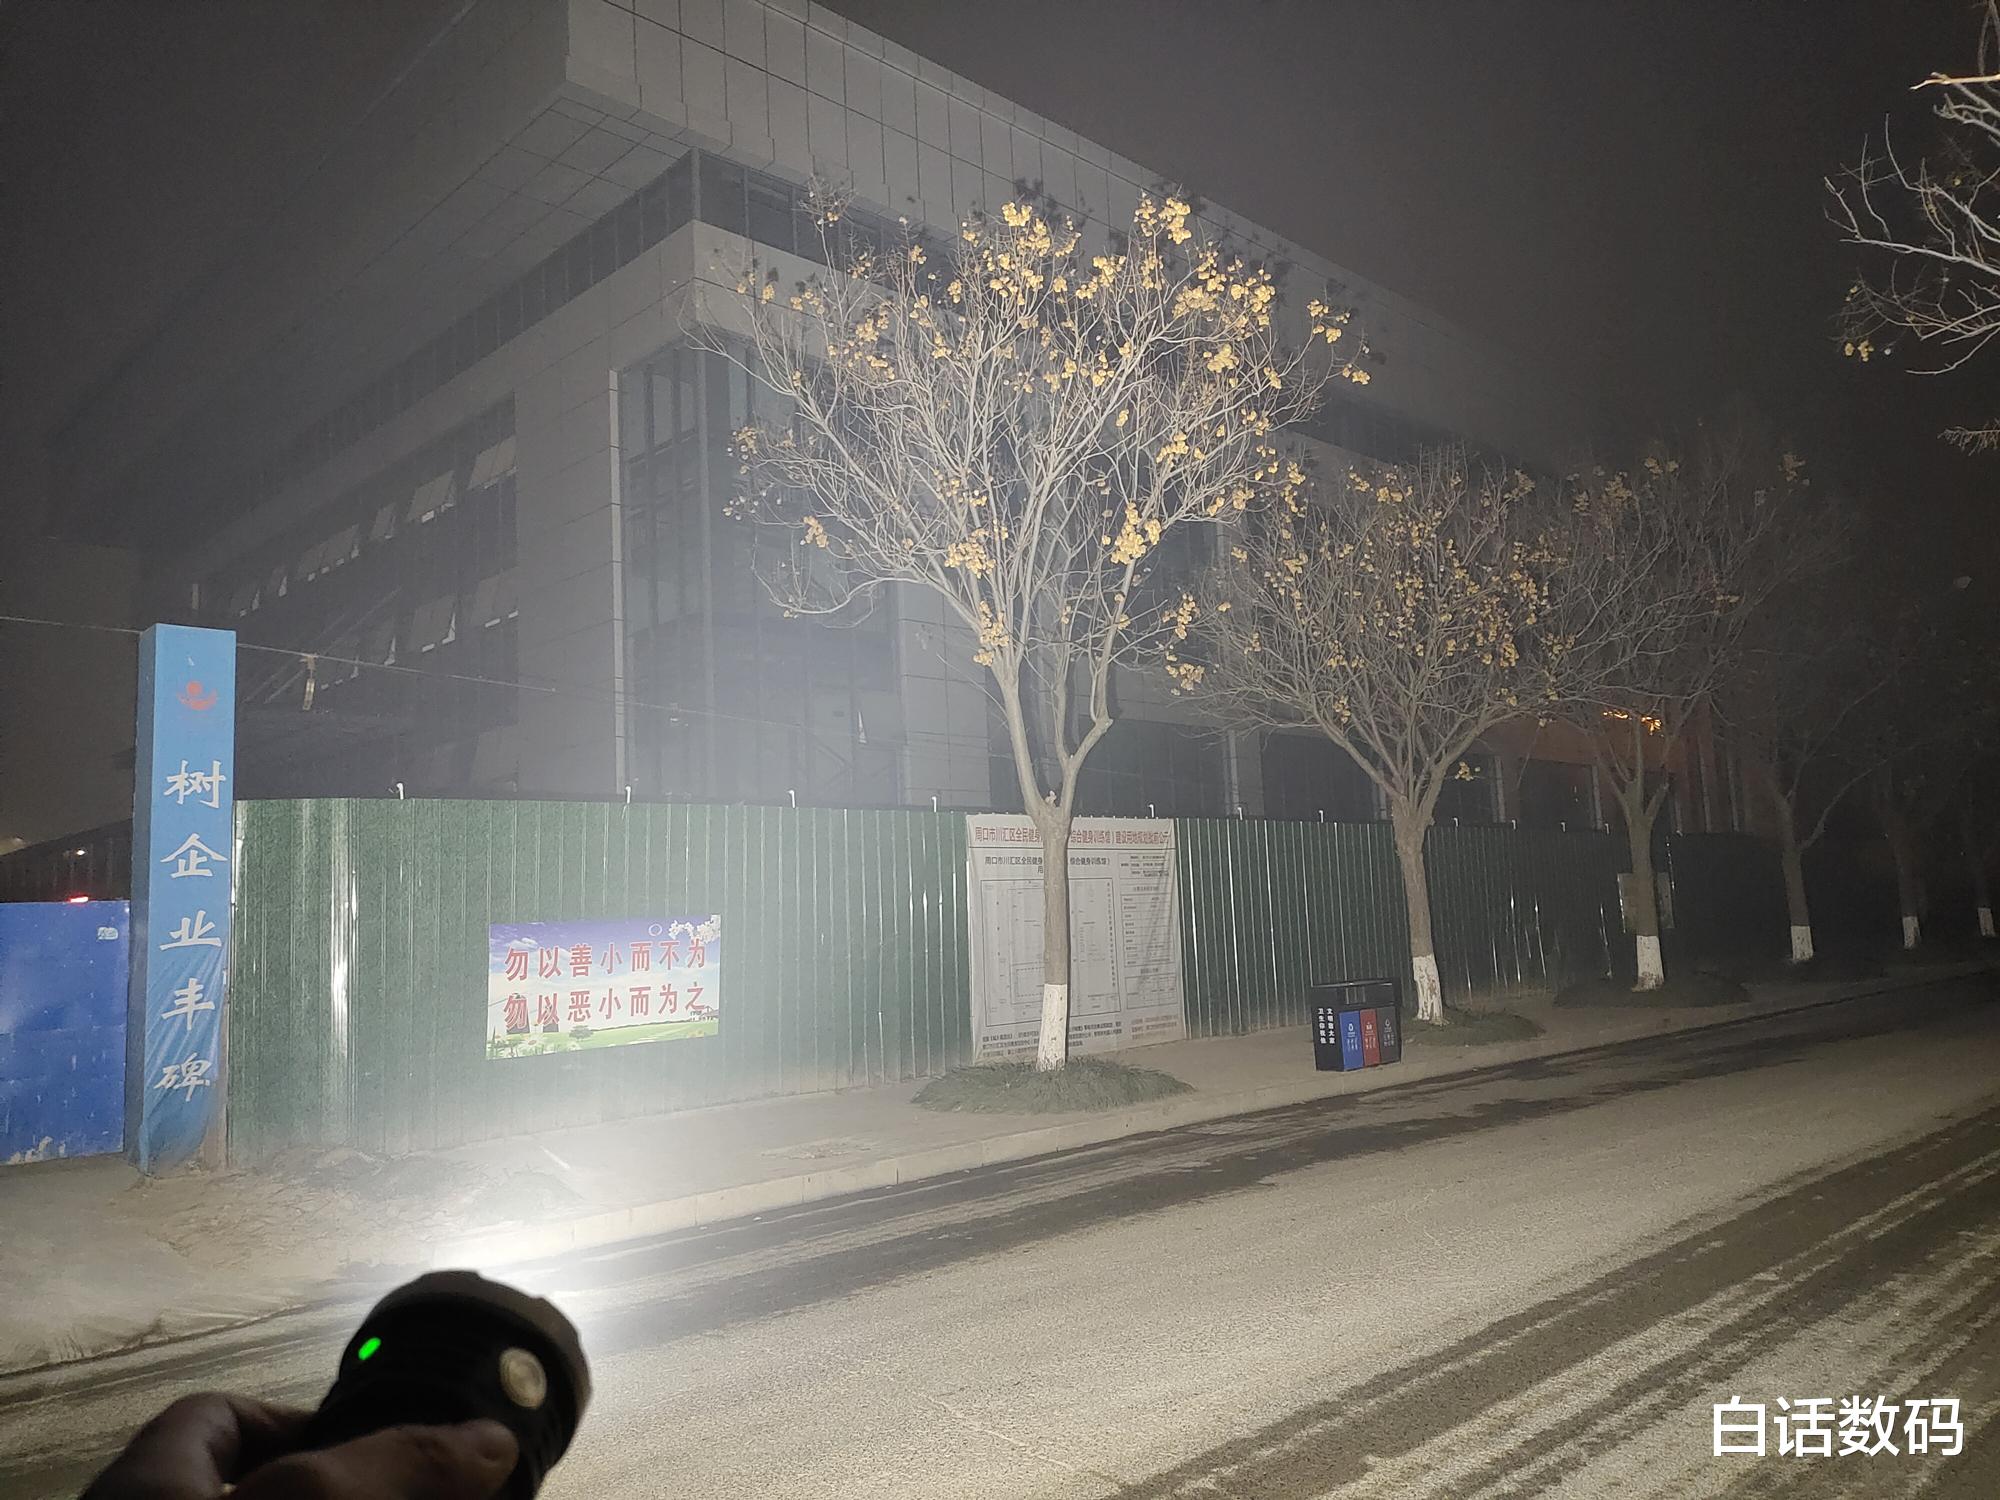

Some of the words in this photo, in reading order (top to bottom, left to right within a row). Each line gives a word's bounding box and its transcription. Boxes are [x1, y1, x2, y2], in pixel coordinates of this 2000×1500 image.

[975, 826, 1043, 843] 周口市川汇区全民健身
[153, 759, 228, 1101] 树企业丰碑
[504, 937, 706, 982] 勿以善小而不为
[503, 981, 705, 1030] 勿以恶小而为之
